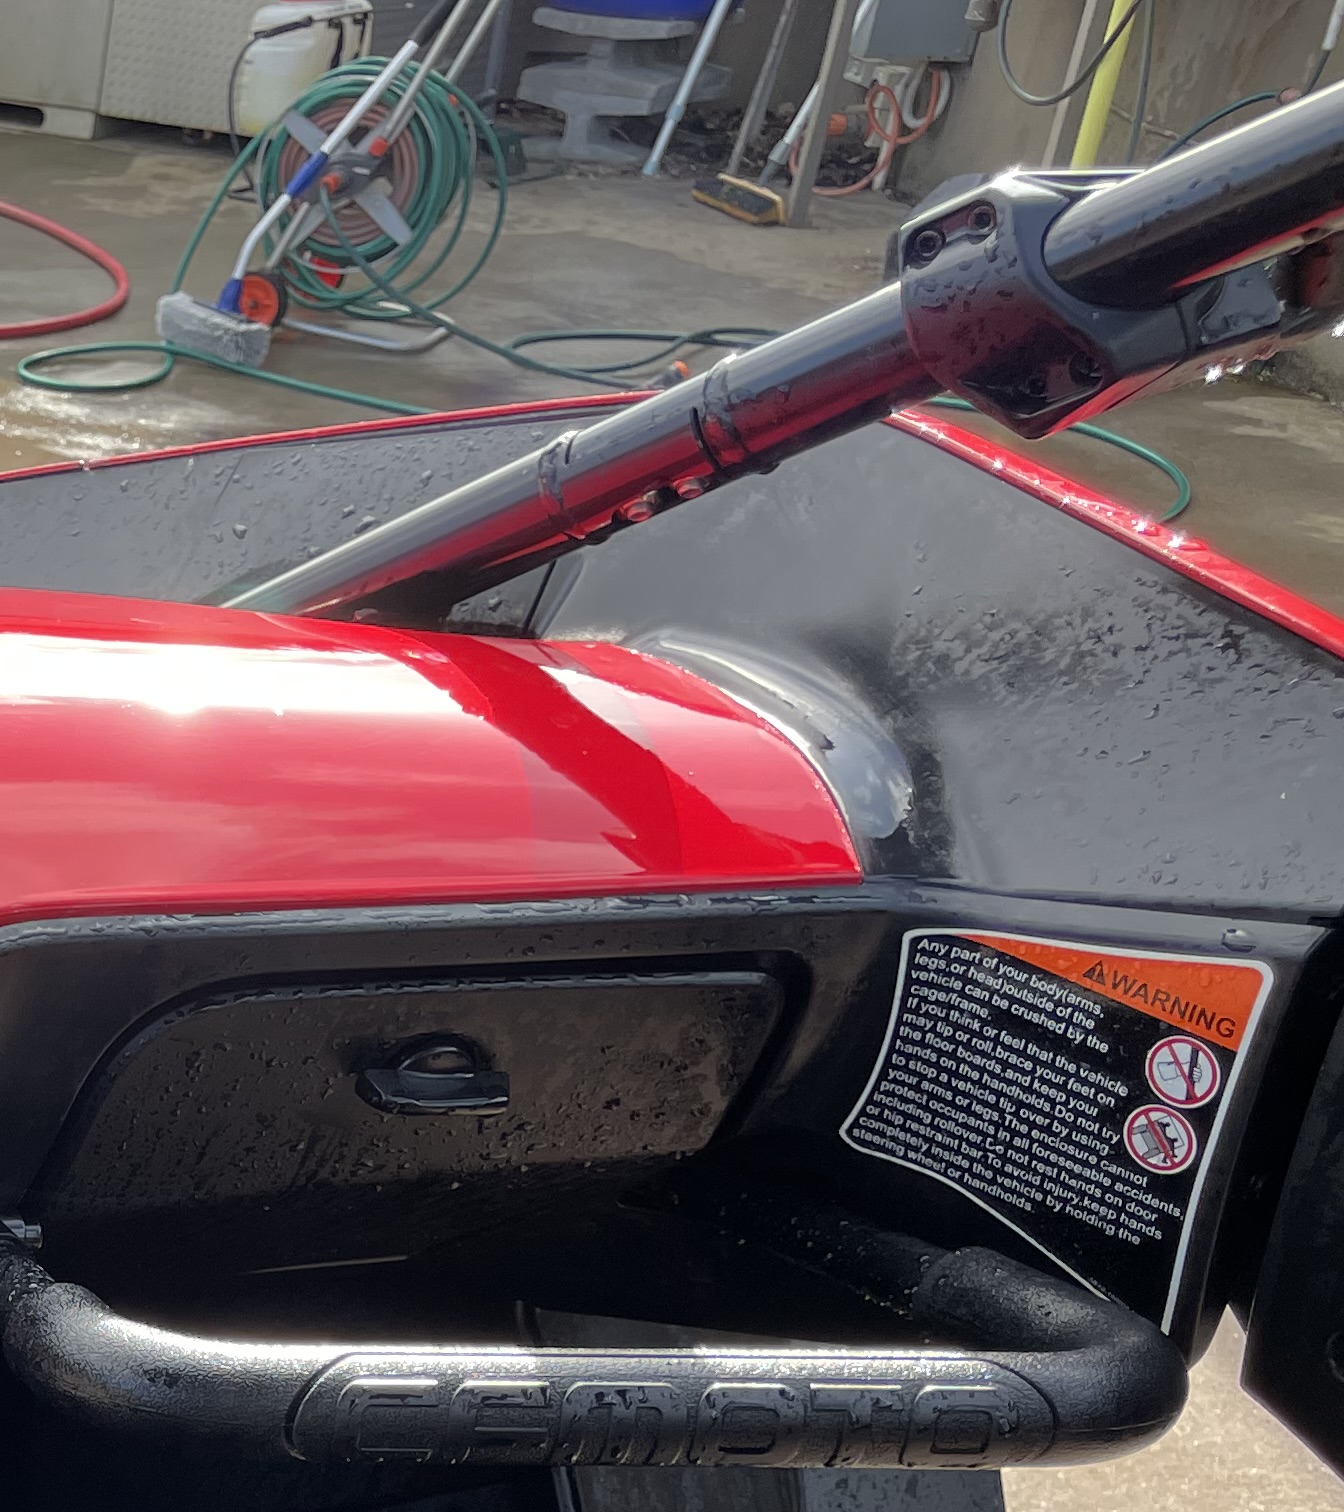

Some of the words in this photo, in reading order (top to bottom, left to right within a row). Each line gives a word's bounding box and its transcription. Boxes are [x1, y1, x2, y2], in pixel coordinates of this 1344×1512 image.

[911, 984, 992, 1020] cage/frame.
[918, 938, 949, 956] Any
[951, 945, 981, 964] part
[983, 957, 998, 970] of
[998, 962, 1028, 983] your
[1112, 970, 1236, 1038] WARNING
[907, 997, 918, 1009] If
[920, 1002, 947, 1018] you
[949, 1009, 981, 1032] think
[983, 1025, 998, 1038] or
[1000, 1030, 1025, 1050] feel
[1027, 1043, 1053, 1063] that
[1056, 1055, 1076, 1073] the
[1080, 1067, 1128, 1096] vehicle
[912, 970, 962, 990] vehicle
[965, 983, 989, 1001] can
[992, 994, 1009, 1009] be
[1011, 1003, 1065, 1034] crushed
[1067, 1028, 1084, 1044] by
[1087, 1034, 1109, 1053] the
[1056, 1004, 1071, 1019] of
[1073, 1013, 1095, 1030] the
[892, 1053, 906, 1065] to
[909, 1060, 937, 1078] stop
[939, 1072, 948, 1082] a
[951, 1077, 996, 1103] vehicle
[999, 1097, 1015, 1113] tip
[1020, 1108, 1050, 1127] over
[1052, 1120, 1069, 1137] by
[1072, 1131, 1109, 1156] using
[896, 1039, 937, 1062] hands
[940, 1054, 956, 1069] on
[959, 1063, 980, 1081] the
[1077, 1117, 1100, 1134] not
[1102, 1127, 1120, 1144] try
[899, 1026, 922, 1041] the
[925, 1032, 955, 1052] floor
[1033, 1076, 1066, 1103] keep
[1069, 1097, 1098, 1117] your
[902, 1013, 934, 1030] may
[936, 1021, 953, 1037] tip
[955, 1029, 971, 1043] or
[1036, 1064, 1065, 1085] your
[1067, 1077, 1095, 1097] feet
[1097, 1093, 1115, 1107] on
[852, 1128, 904, 1156] steering
[907, 1150, 945, 1172] wheel
[947, 1167, 962, 1179] or
[964, 1172, 1035, 1213] handholds.
[866, 1105, 880, 1116] or
[884, 1109, 904, 1125] hip
[906, 1120, 959, 1150] restraint
[1004, 1163, 1040, 1185] avoid
[1120, 1213, 1162, 1240] hands
[873, 1092, 932, 1124] including
[1007, 1149, 1029, 1166] not
[1032, 1159, 1057, 1177] rest
[1060, 1171, 1102, 1198] hands
[1105, 1192, 1122, 1207] on
[1126, 1202, 1158, 1221] door
[880, 1080, 927, 1105] protect
[929, 1099, 995, 1135] occupants
[997, 1128, 1010, 1141] in
[1013, 1135, 1030, 1150] all
[1032, 1142, 1112, 1186] foreseeable
[1114, 1181, 1183, 1220] accidents,
[888, 1068, 919, 1085] your
[921, 1080, 952, 1100] arms
[956, 1095, 970, 1107] or
[1031, 1131, 1097, 1164] enclosure
[1100, 1160, 1148, 1188] cannot
[859, 1116, 930, 1152] completely
[931, 1145, 970, 1168] inside
[972, 1162, 993, 1179] the
[997, 1175, 1043, 1200] vehicle
[1046, 1195, 1063, 1212] by
[1065, 1204, 1115, 1235] holding
[1118, 1228, 1140, 1245] the
